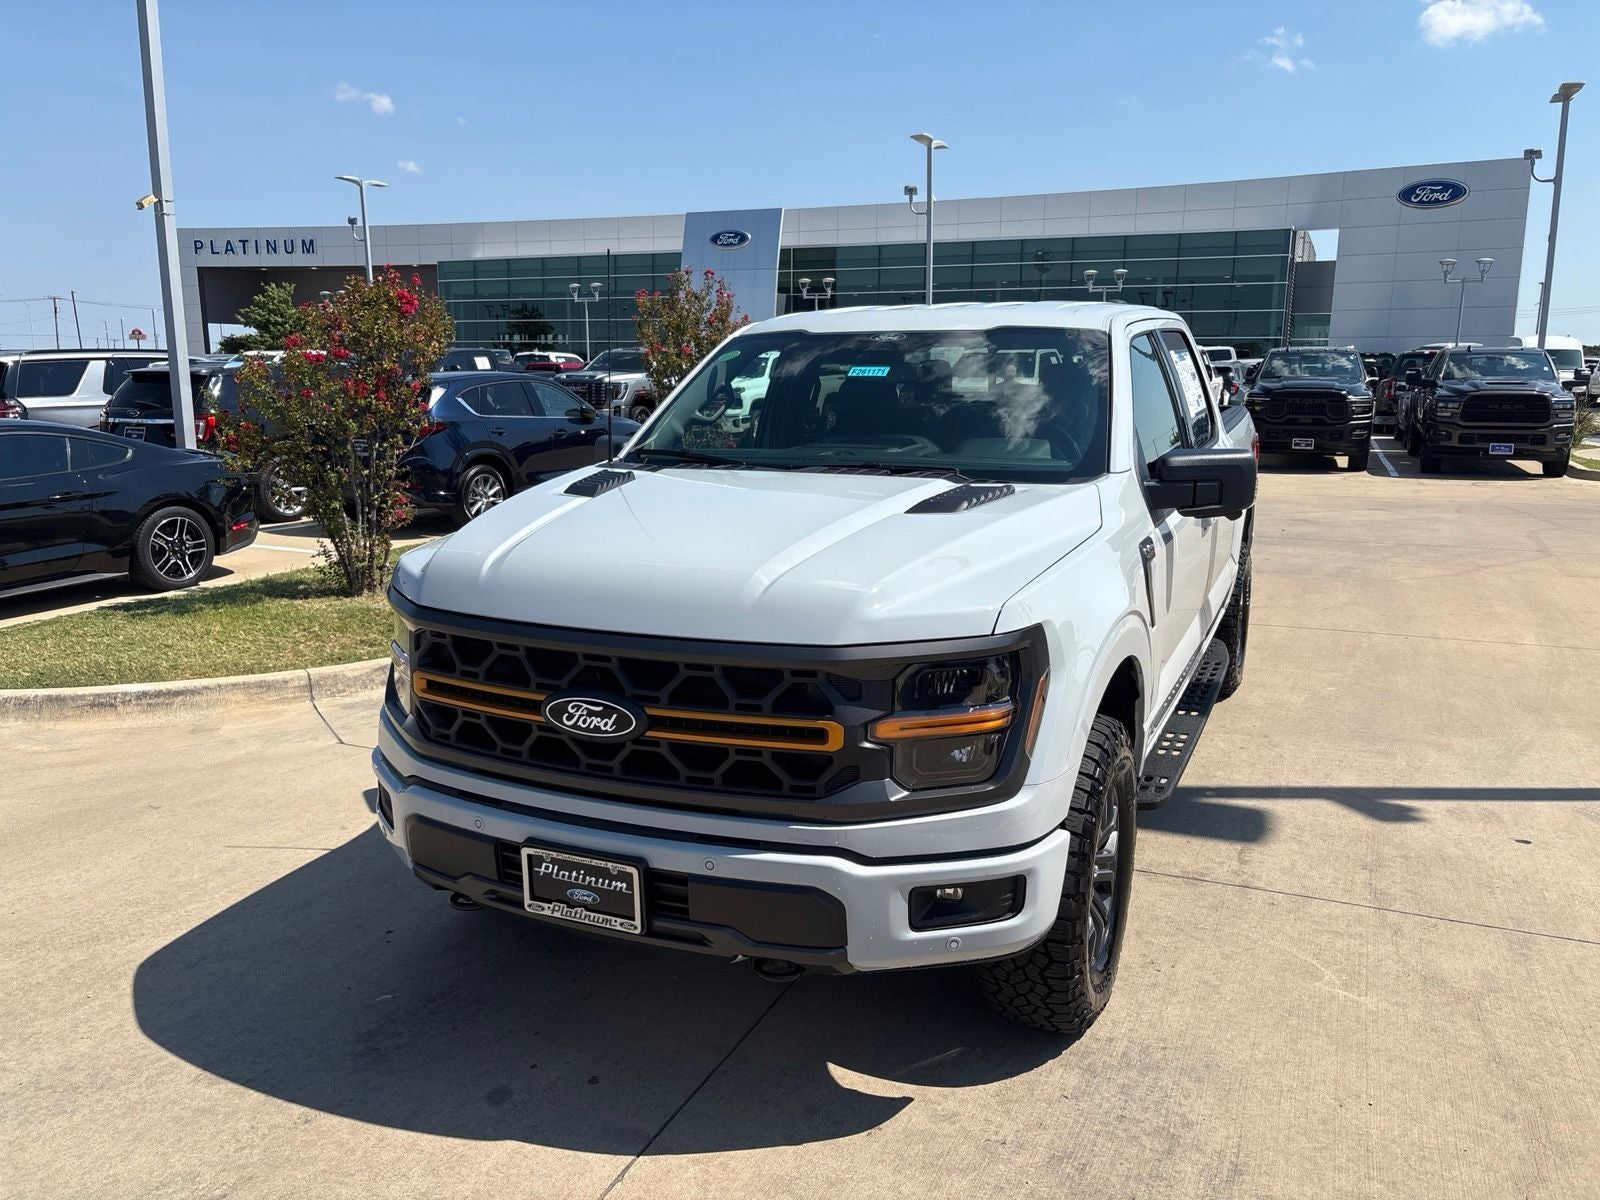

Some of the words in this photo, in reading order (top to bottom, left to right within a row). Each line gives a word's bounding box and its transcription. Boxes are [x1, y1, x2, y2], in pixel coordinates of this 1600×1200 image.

[1411, 185, 1453, 202] Ford
[193, 238, 316, 255] PLATINUM
[717, 233, 741, 245] Ford
[562, 701, 618, 732] Ford
[534, 862, 632, 894] Platinum
[573, 890, 594, 902] Ford
[551, 902, 617, 926] Platinum
